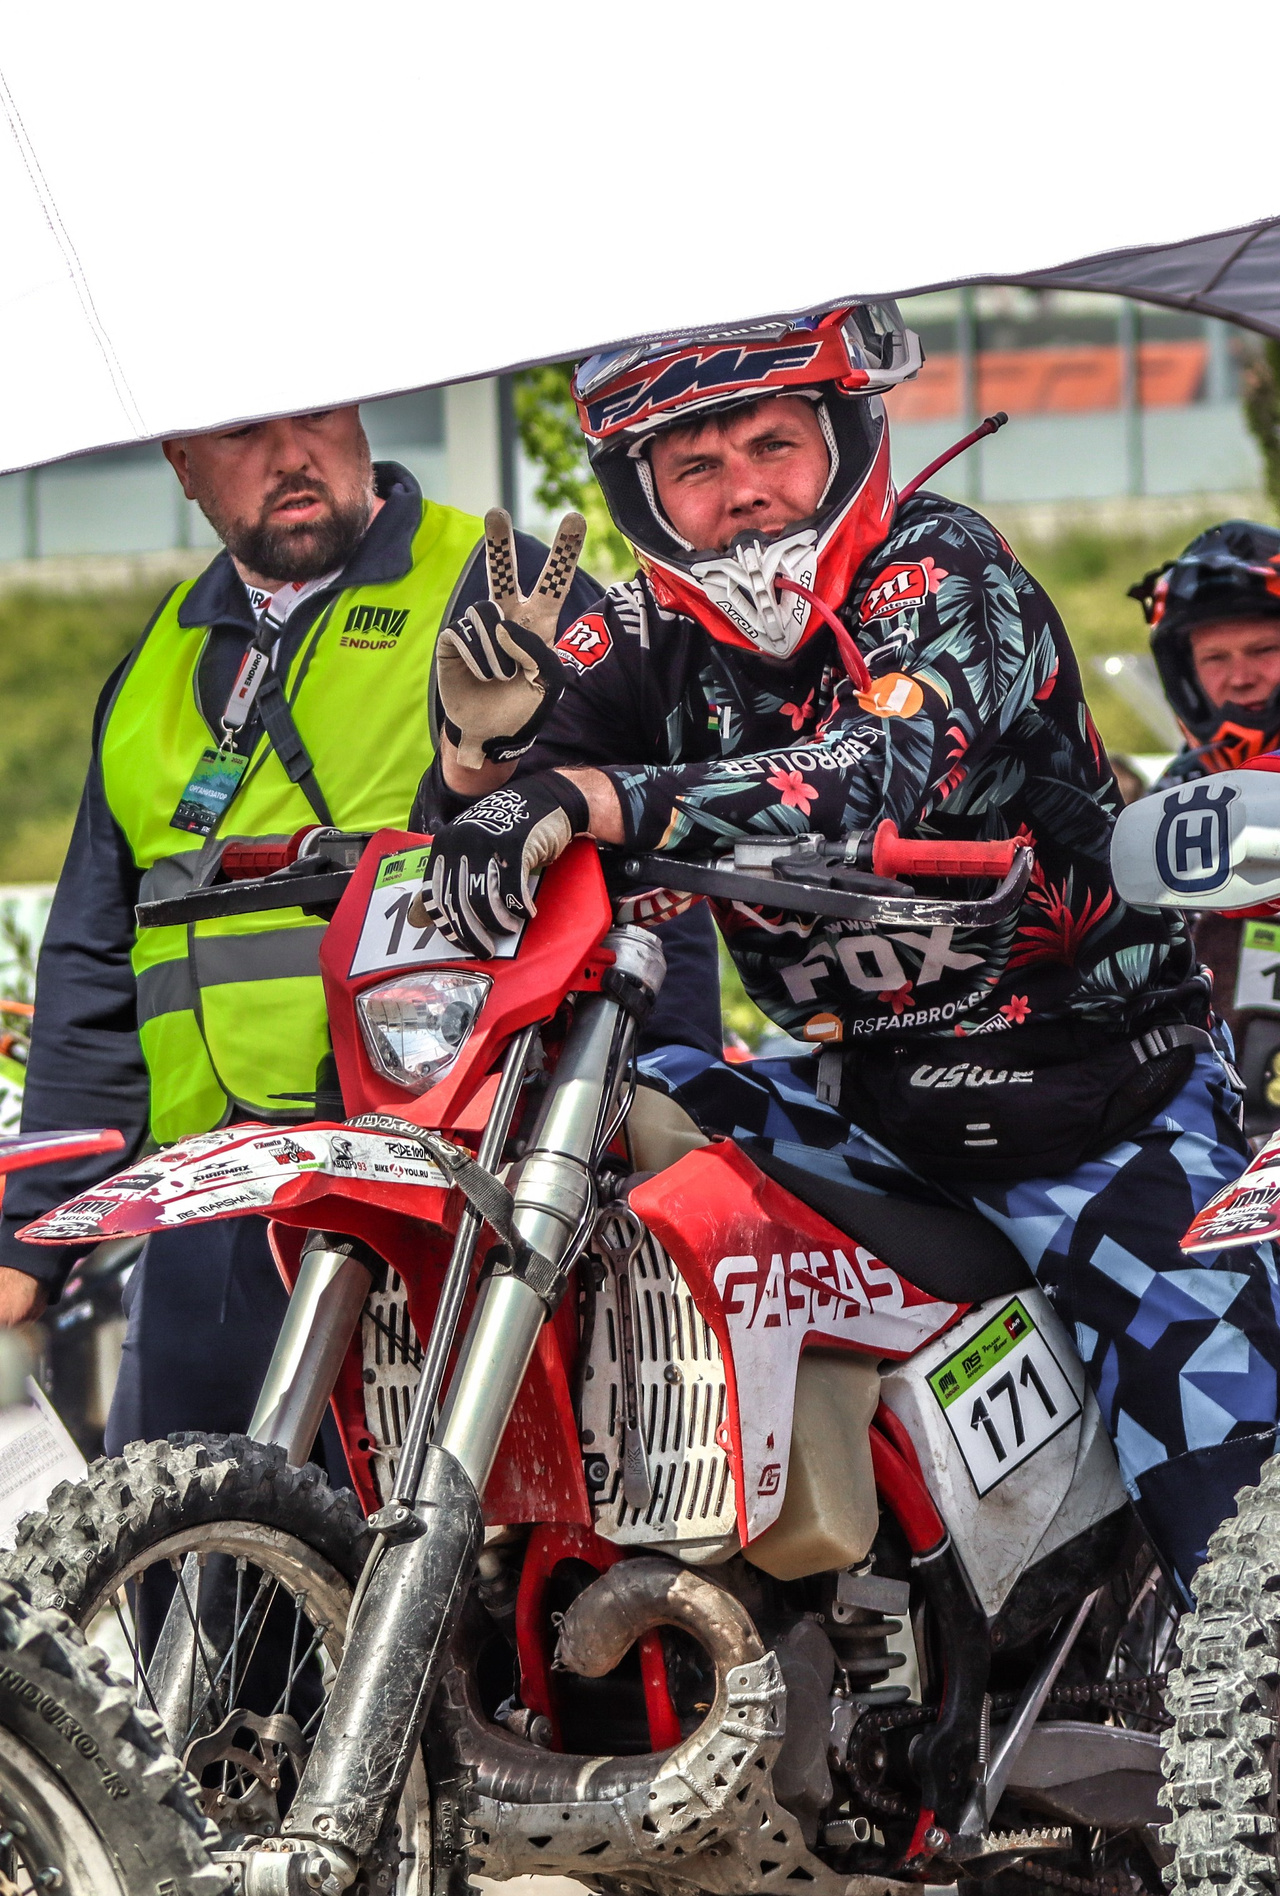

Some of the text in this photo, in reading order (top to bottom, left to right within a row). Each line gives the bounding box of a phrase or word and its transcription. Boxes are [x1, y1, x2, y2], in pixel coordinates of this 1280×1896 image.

[340, 636, 398, 650] ENDURO
[244, 653, 263, 686] ENDURO
[189, 783, 228, 801] ОРГАНИЗАТОР
[780, 926, 986, 1004] FOX
[113, 1176, 150, 1186] LAVR
[714, 1247, 905, 1330] GASGAS
[970, 1354, 1058, 1464] 171
